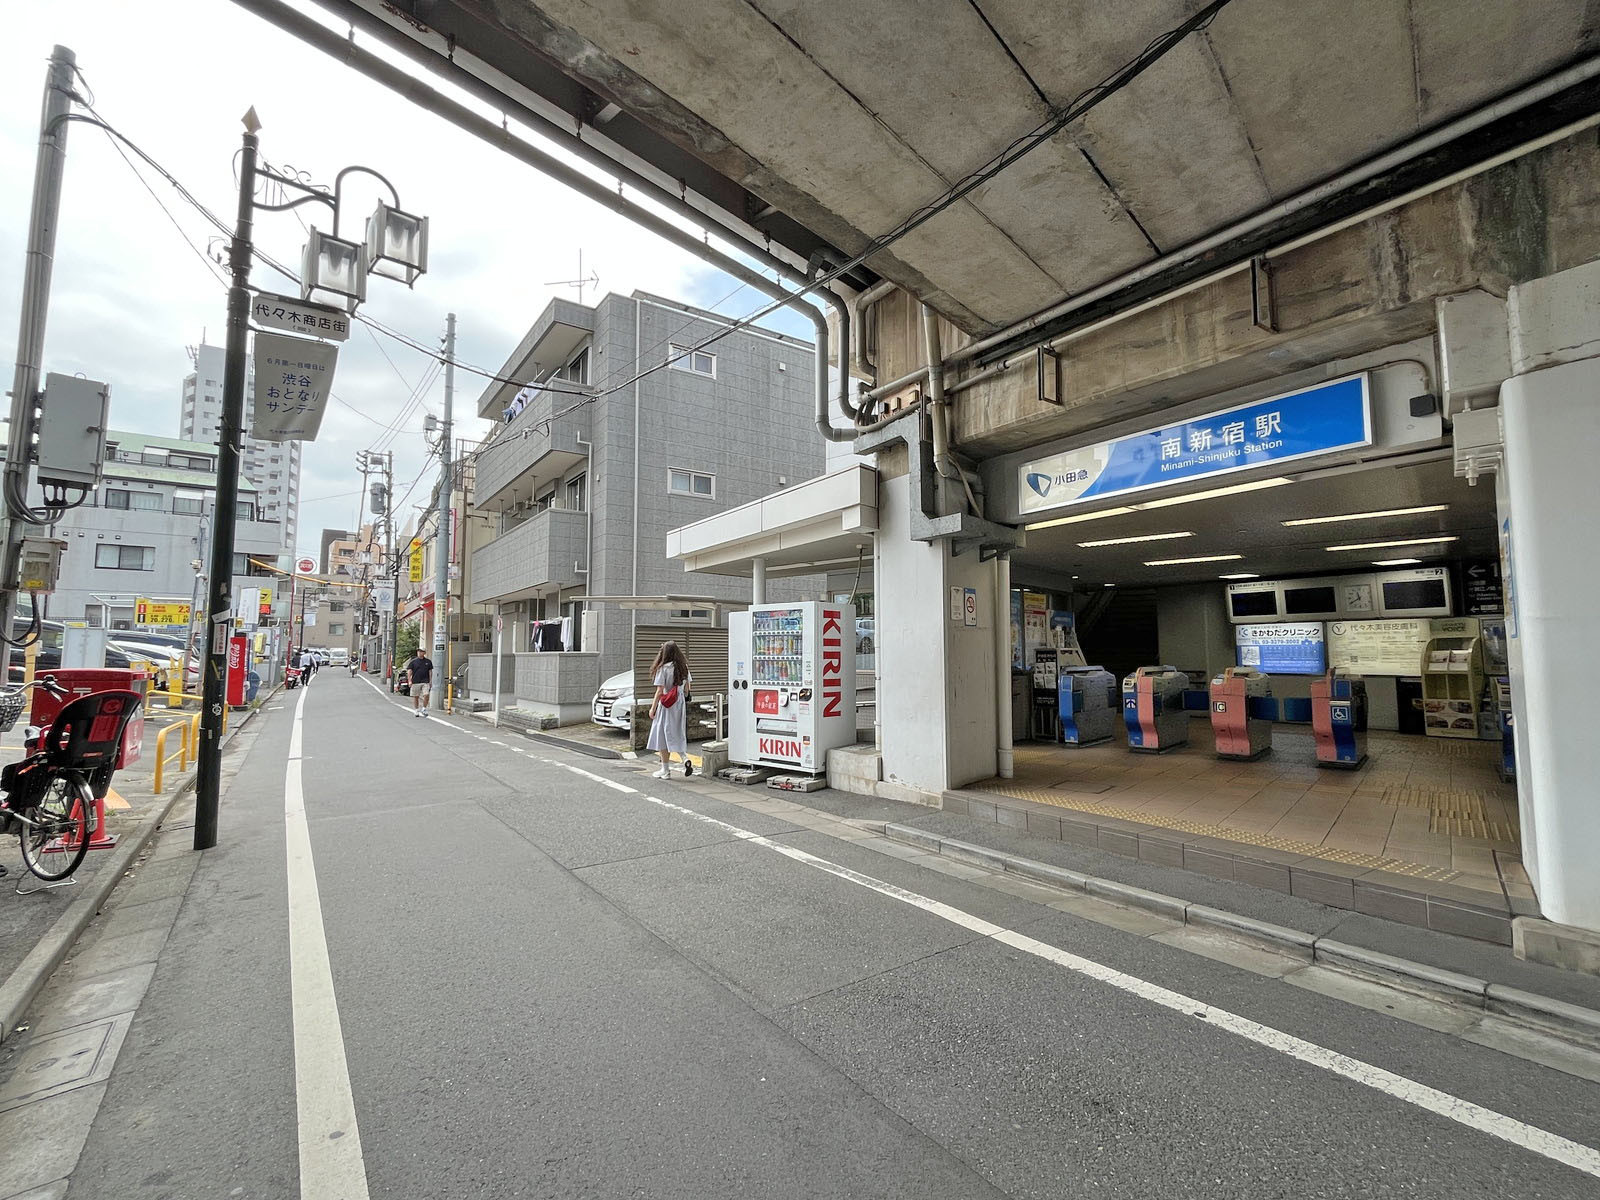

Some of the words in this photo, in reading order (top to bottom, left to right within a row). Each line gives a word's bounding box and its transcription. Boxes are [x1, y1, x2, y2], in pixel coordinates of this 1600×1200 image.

[255, 303, 346, 333] 代々木商店街
[282, 372, 312, 388] 渋谷
[267, 386, 320, 402] おとなり
[266, 401, 316, 415] サンデー
[1160, 411, 1282, 460] 南新宿駅
[1161, 447, 1241, 472] Minami-Shinjuku
[1243, 439, 1283, 454] Station
[1054, 469, 1089, 486] 小田急
[1251, 628, 1320, 637] きかわだクリニック
[823, 609, 841, 718] KIRIN
[759, 737, 801, 758] KIRIN
